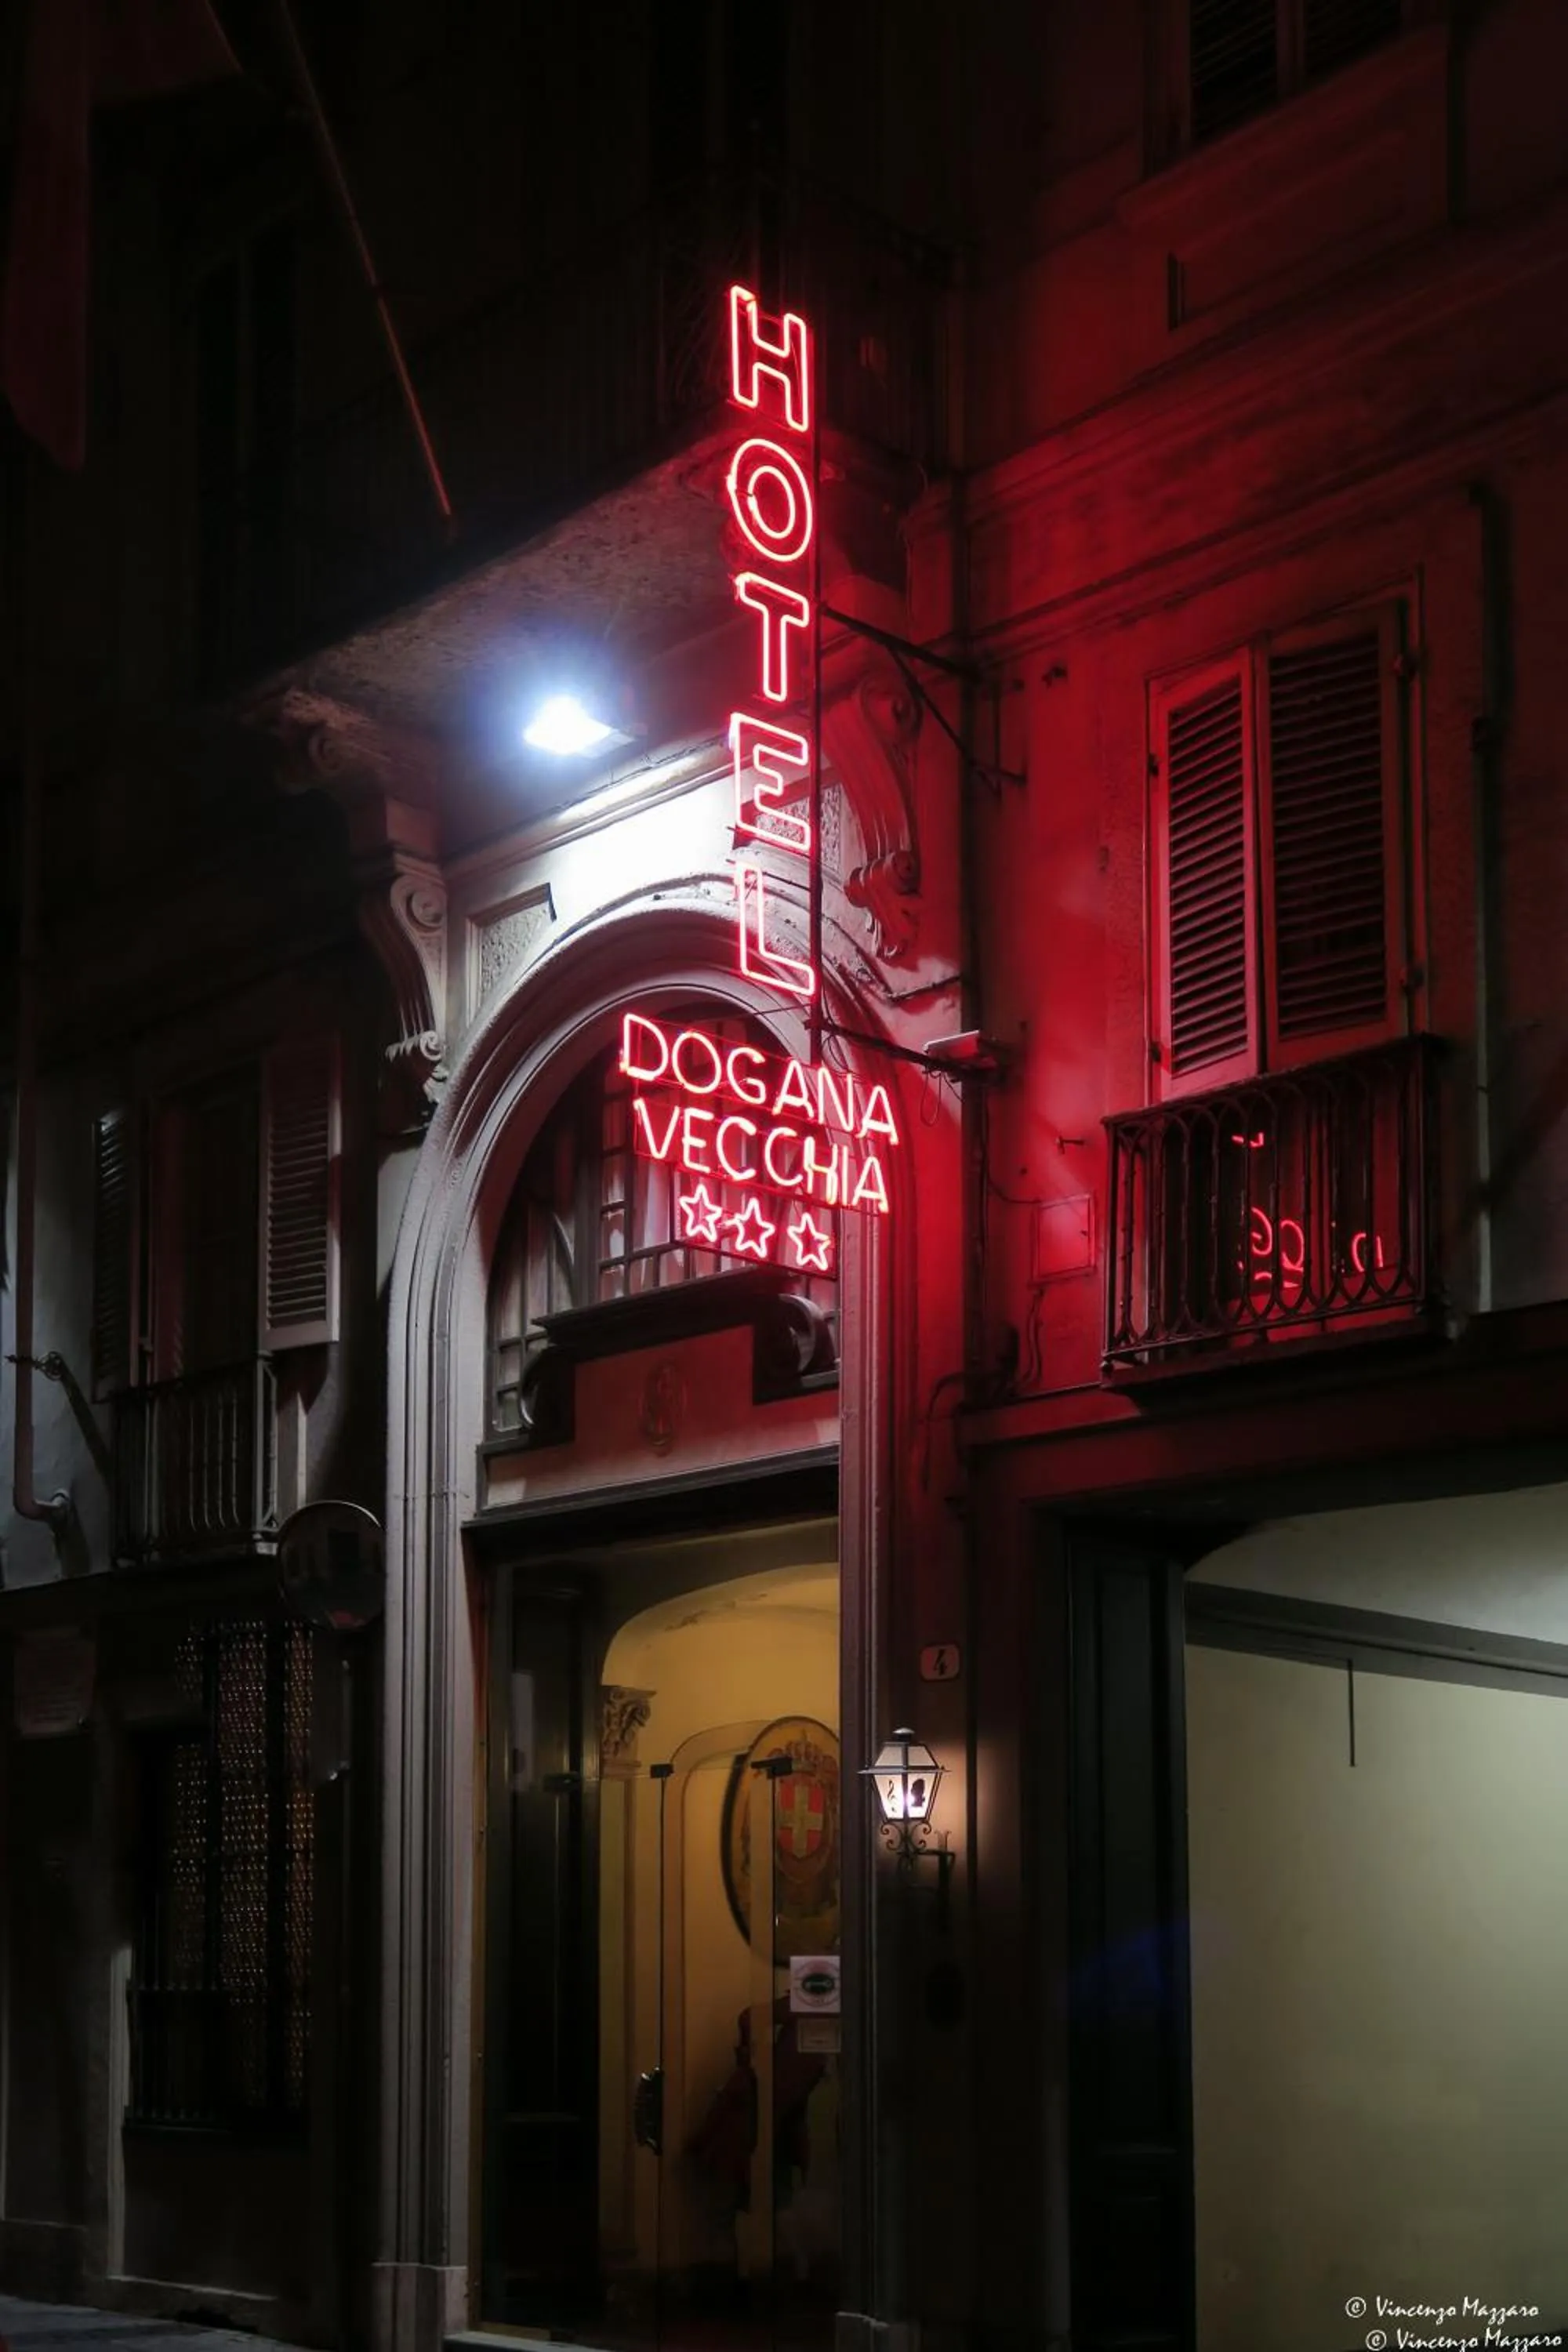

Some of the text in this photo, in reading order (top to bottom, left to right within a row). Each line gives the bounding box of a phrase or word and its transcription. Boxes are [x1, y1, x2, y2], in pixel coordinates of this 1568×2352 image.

[729, 285, 817, 997] HOTEL
[619, 1013, 899, 1146] DOGANA
[633, 1098, 889, 1214] VECCHIA
[932, 1648, 948, 1676] 4
